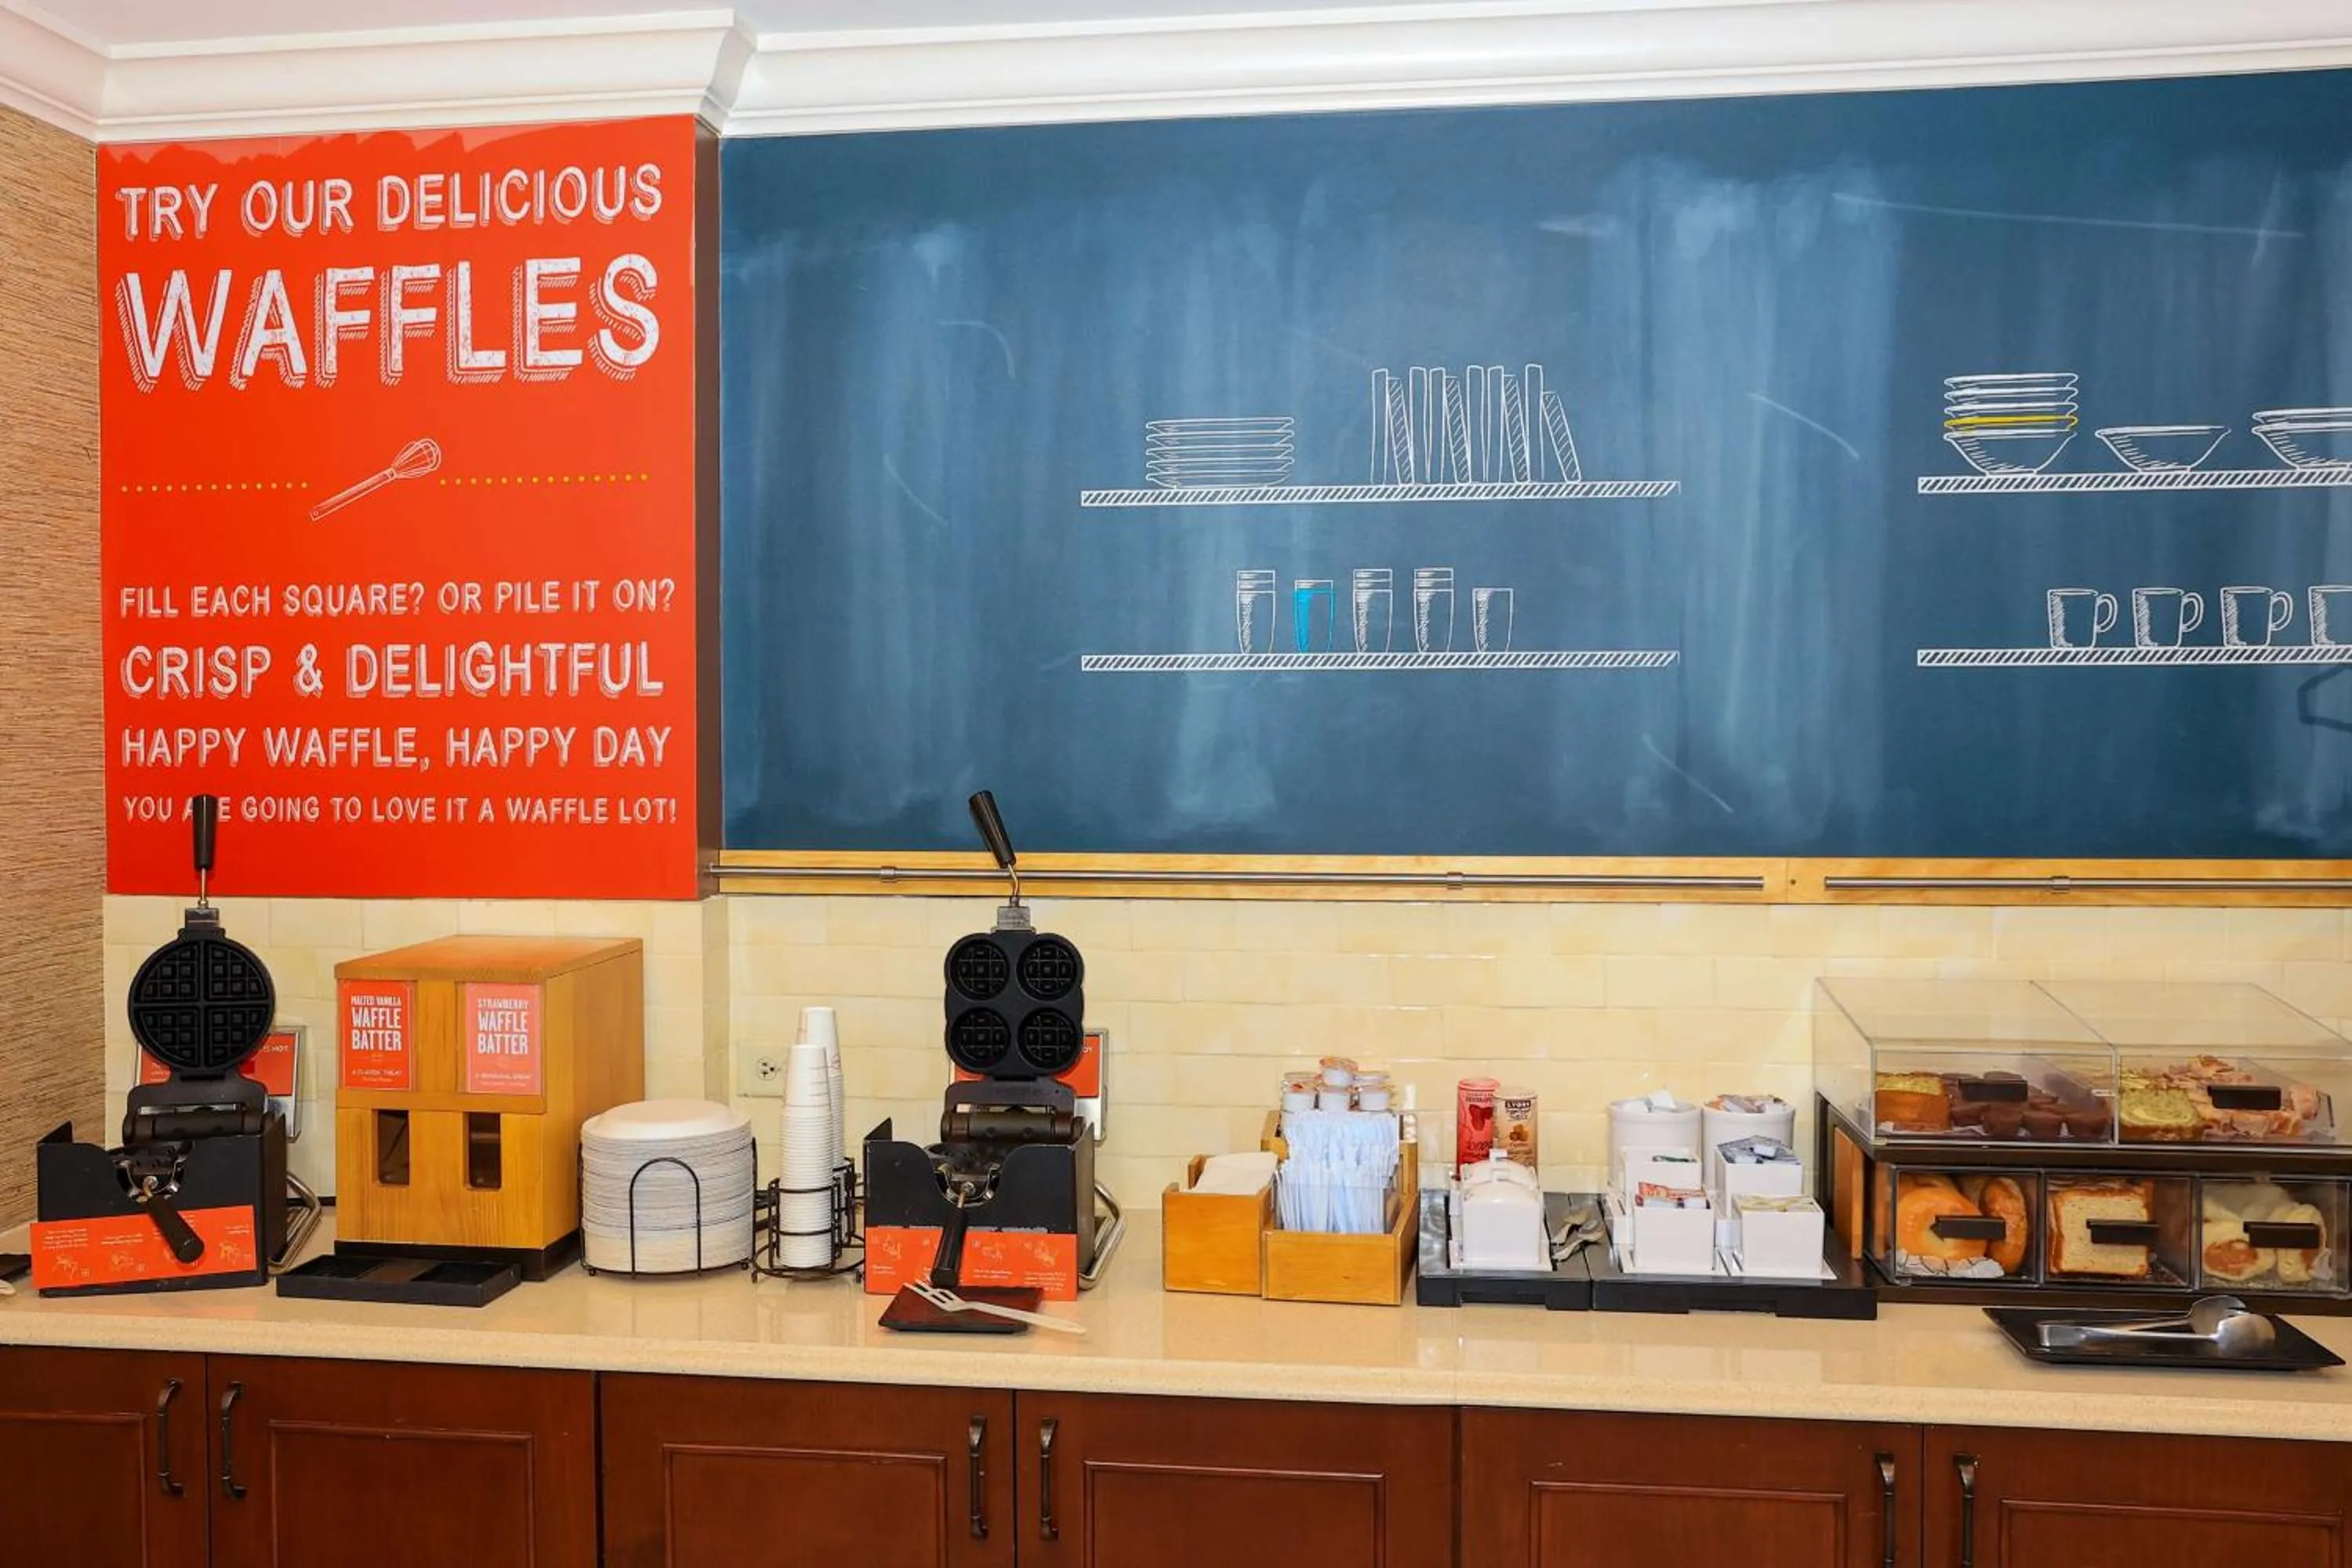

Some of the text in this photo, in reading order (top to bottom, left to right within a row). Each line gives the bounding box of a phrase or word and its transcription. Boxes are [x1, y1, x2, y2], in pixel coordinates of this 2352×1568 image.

[116, 163, 662, 241] TRY OUR DELICIOUS
[116, 253, 660, 394] WAFFLES
[121, 578, 675, 617] FILL EACH SQUARE? OR PILE IT ON?
[122, 641, 664, 699] CRISP & DELIGHTFUL
[122, 727, 672, 771] HAPPY WAFFLE, HAPPY DAY
[124, 796, 677, 823] YOU AE GOING TO LOVE IT A WAFFLE LOT!
[477, 997, 528, 1010] STRAWBERRY
[351, 1007, 402, 1029] WAFFLE
[477, 1011, 528, 1033] WAFFLE
[351, 1029, 402, 1051] BATTER
[477, 1033, 528, 1054] BATTER
